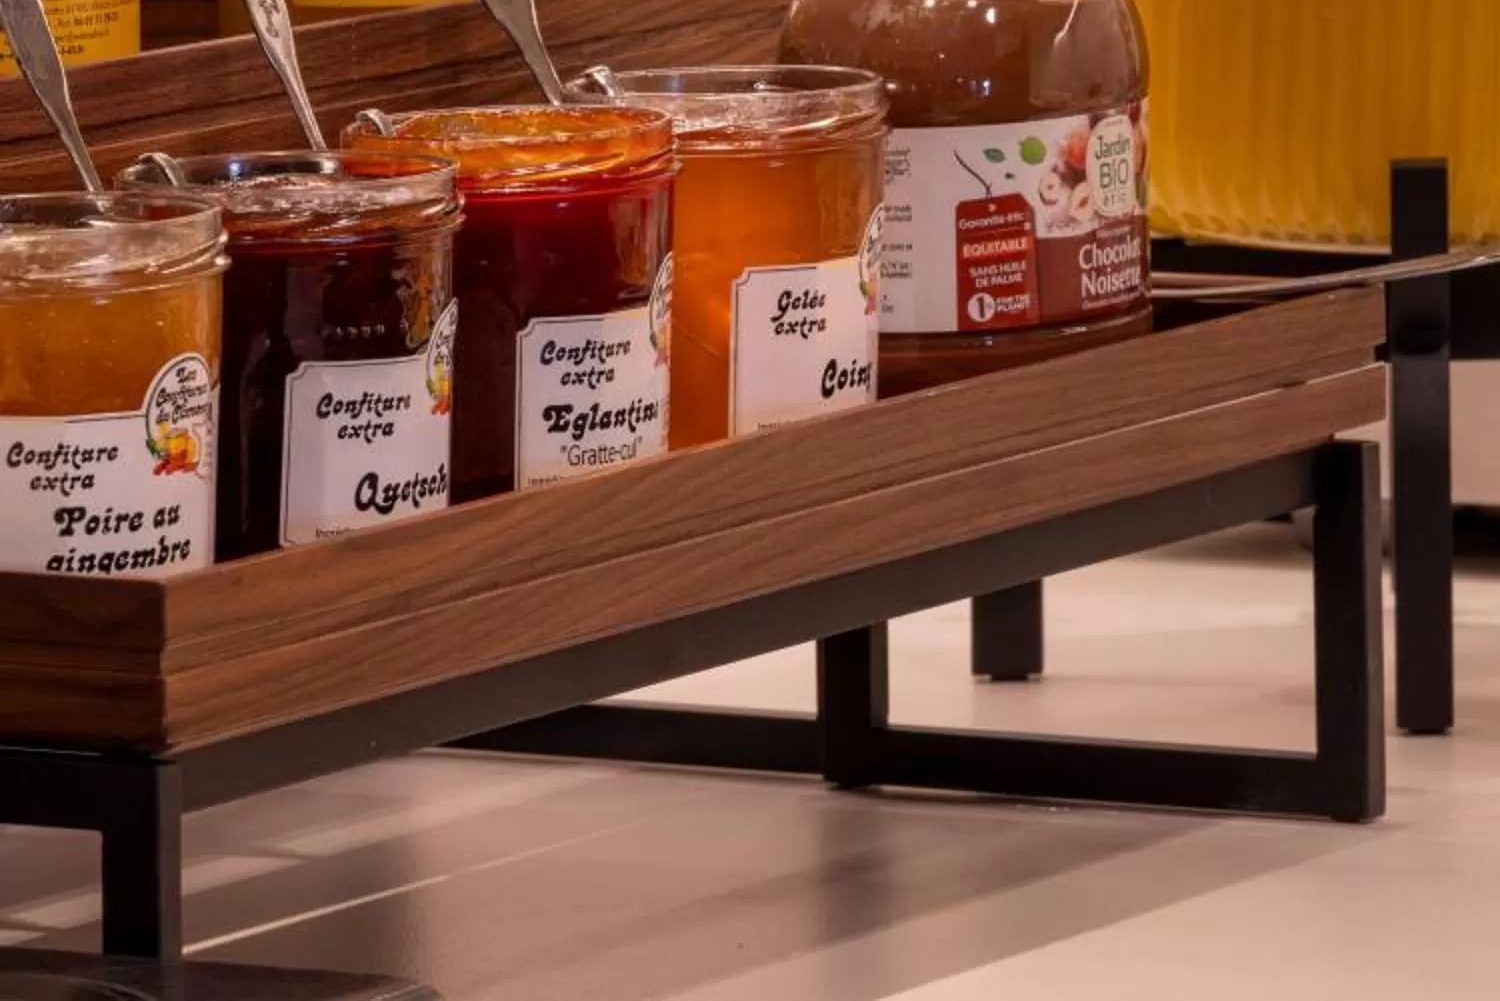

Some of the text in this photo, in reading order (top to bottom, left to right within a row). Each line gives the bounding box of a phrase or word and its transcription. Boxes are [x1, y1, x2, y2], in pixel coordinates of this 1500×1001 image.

[1094, 133, 1131, 161] Jardin
[1079, 235, 1141, 270] Chocolat
[774, 317, 827, 340] extra
[540, 339, 631, 366] Confiture
[560, 366, 615, 390] extra
[337, 418, 394, 444] extra
[6, 441, 119, 471] Confiture
[30, 473, 95, 497] extra
[54, 504, 181, 537] Poire au
